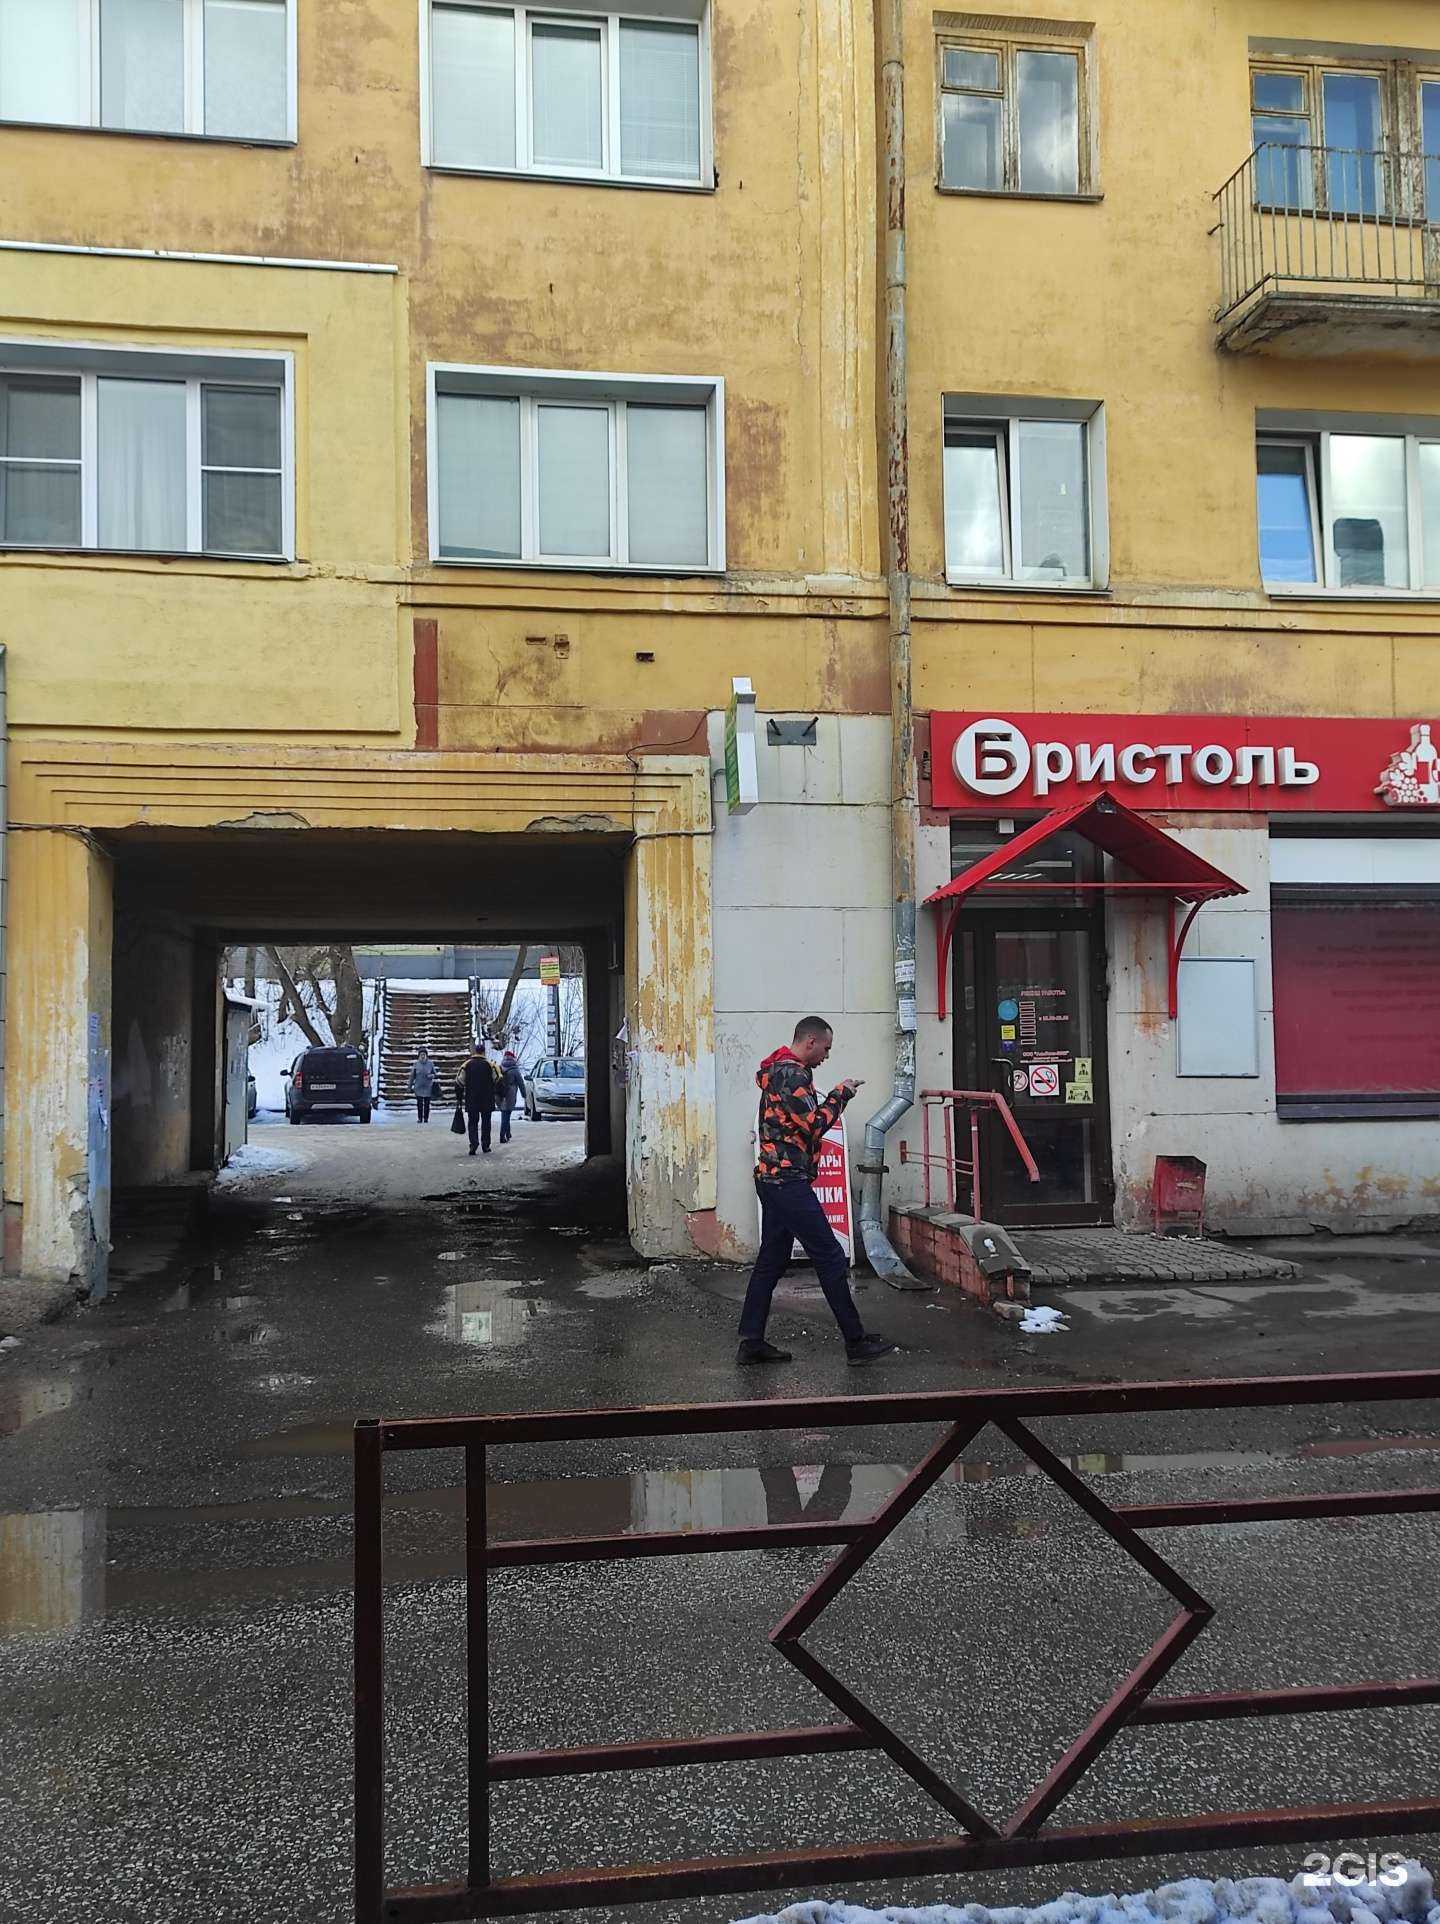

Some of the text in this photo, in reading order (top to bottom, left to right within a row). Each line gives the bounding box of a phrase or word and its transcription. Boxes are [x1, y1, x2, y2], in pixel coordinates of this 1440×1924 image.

[953, 719, 1320, 797] Бристоль
[818, 1155, 842, 1168] АРЫ
[813, 1186, 844, 1204] ШКИ
